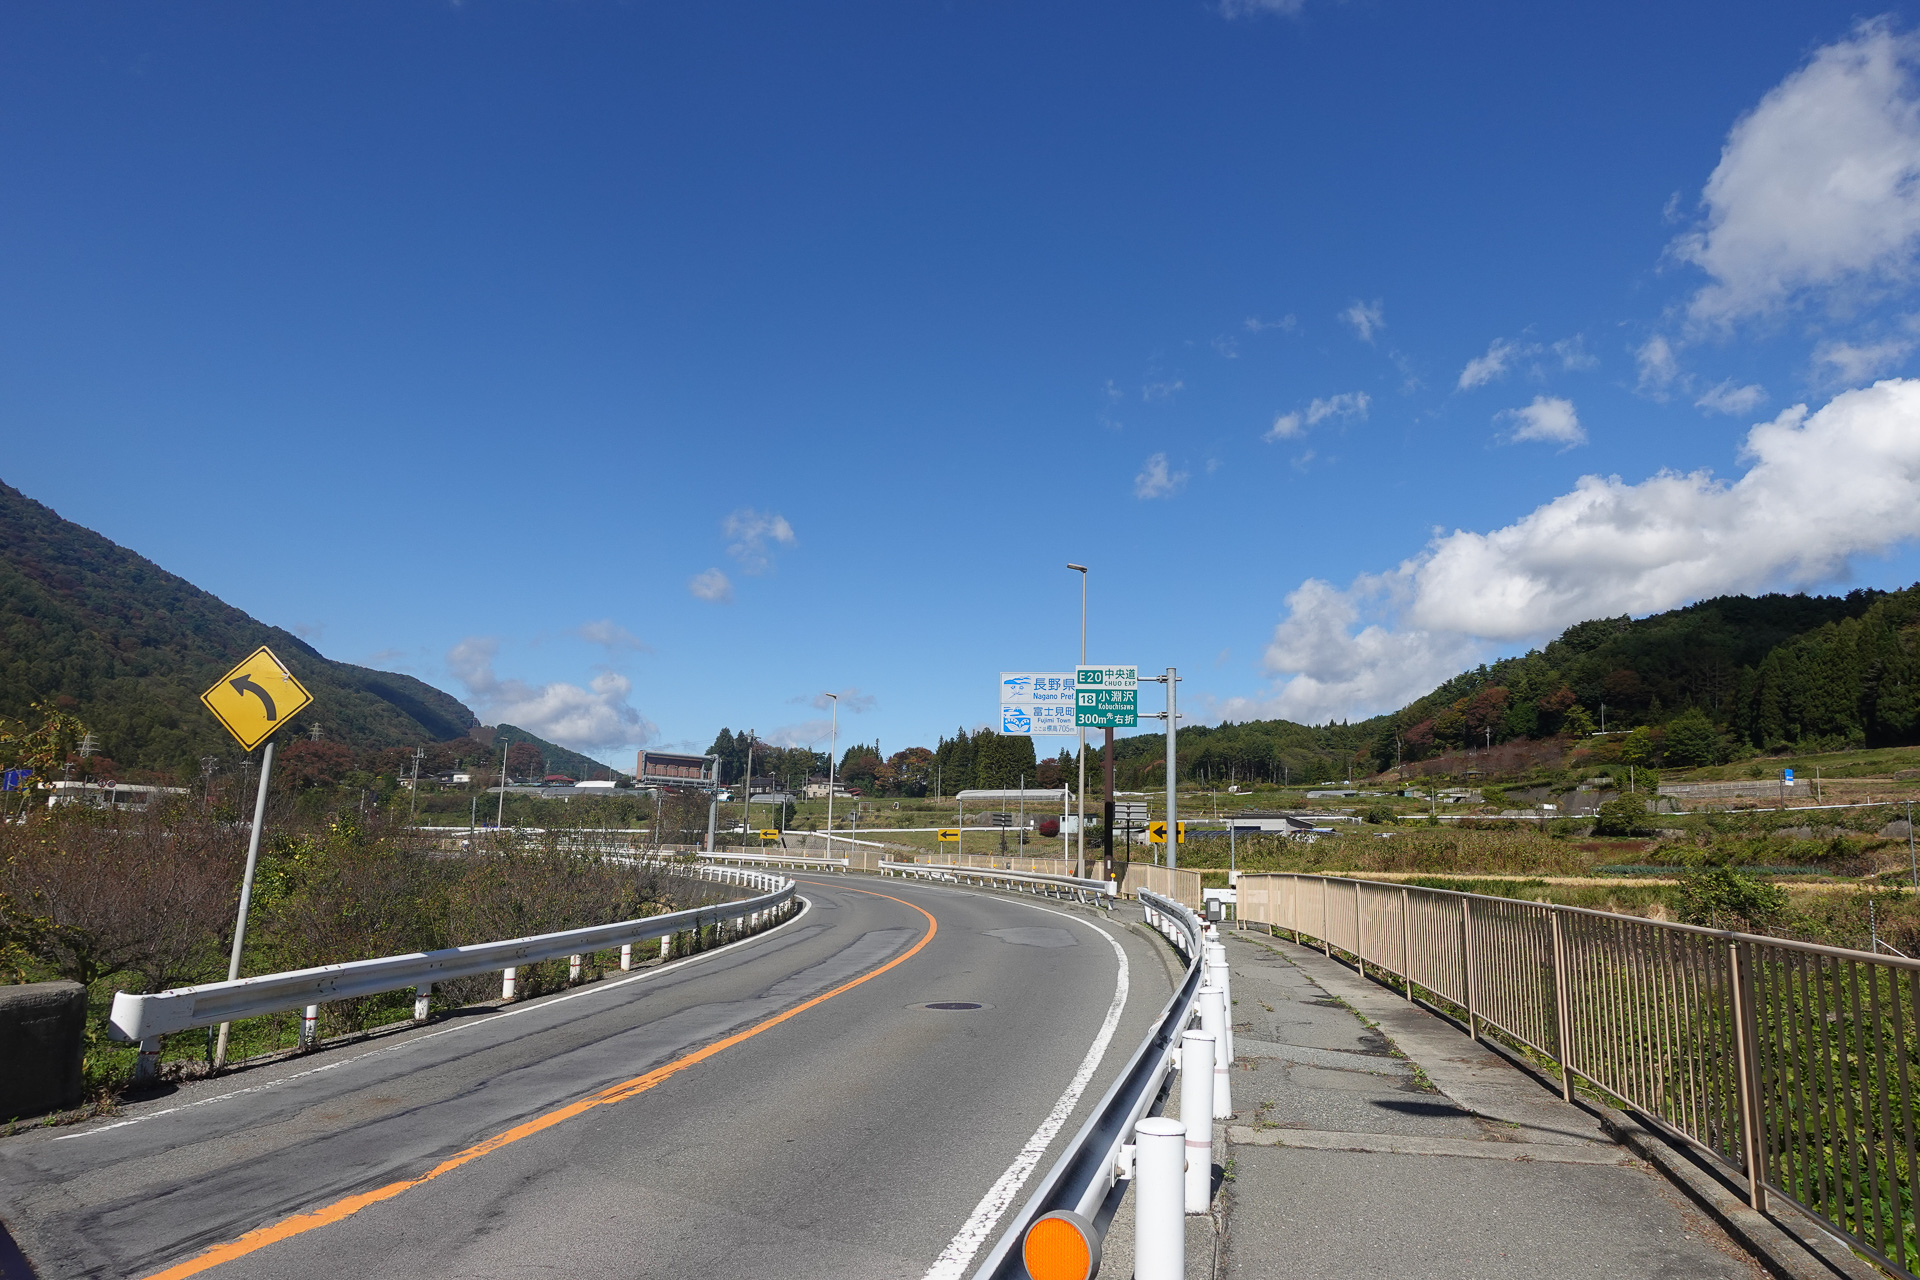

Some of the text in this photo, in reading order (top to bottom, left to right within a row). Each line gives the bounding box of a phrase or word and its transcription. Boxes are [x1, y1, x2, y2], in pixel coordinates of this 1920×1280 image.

[1080, 672, 1102, 682] E20
[1105, 668, 1136, 679] 中央道
[1033, 677, 1076, 691] 長野県
[1033, 692, 1058, 701] Nagano
[1081, 695, 1094, 704] 18
[1098, 690, 1134, 702] 小淵沢
[1098, 702, 1134, 710] Kobuchisawa
[1033, 706, 1075, 717] 富士見町
